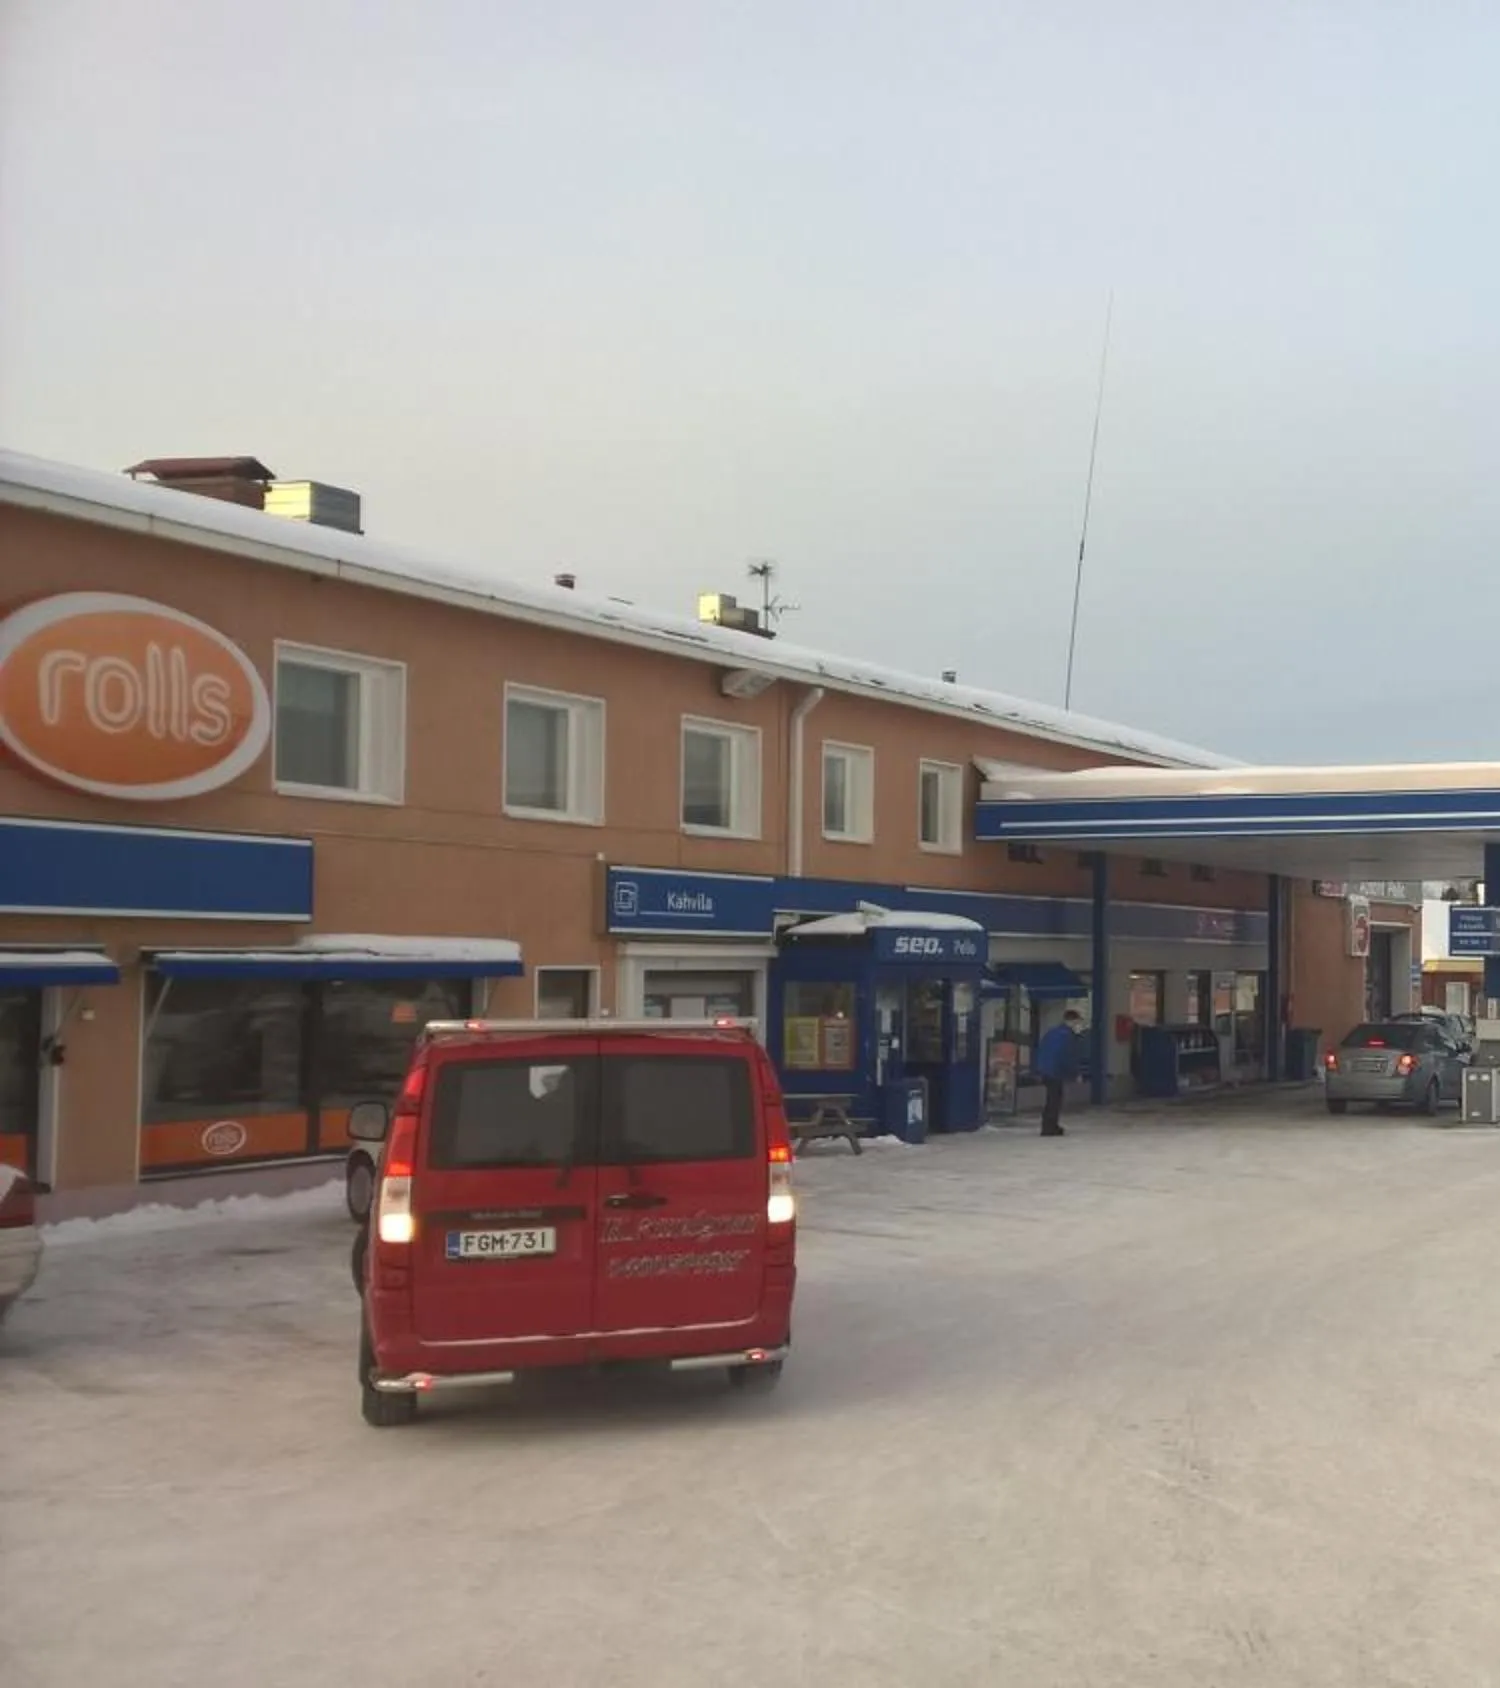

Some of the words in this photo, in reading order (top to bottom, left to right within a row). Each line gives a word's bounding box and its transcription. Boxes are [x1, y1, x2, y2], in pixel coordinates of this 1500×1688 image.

[38, 641, 232, 746] rolls
[667, 891, 714, 912] Kahvila
[463, 1231, 546, 1253] FGM-731
